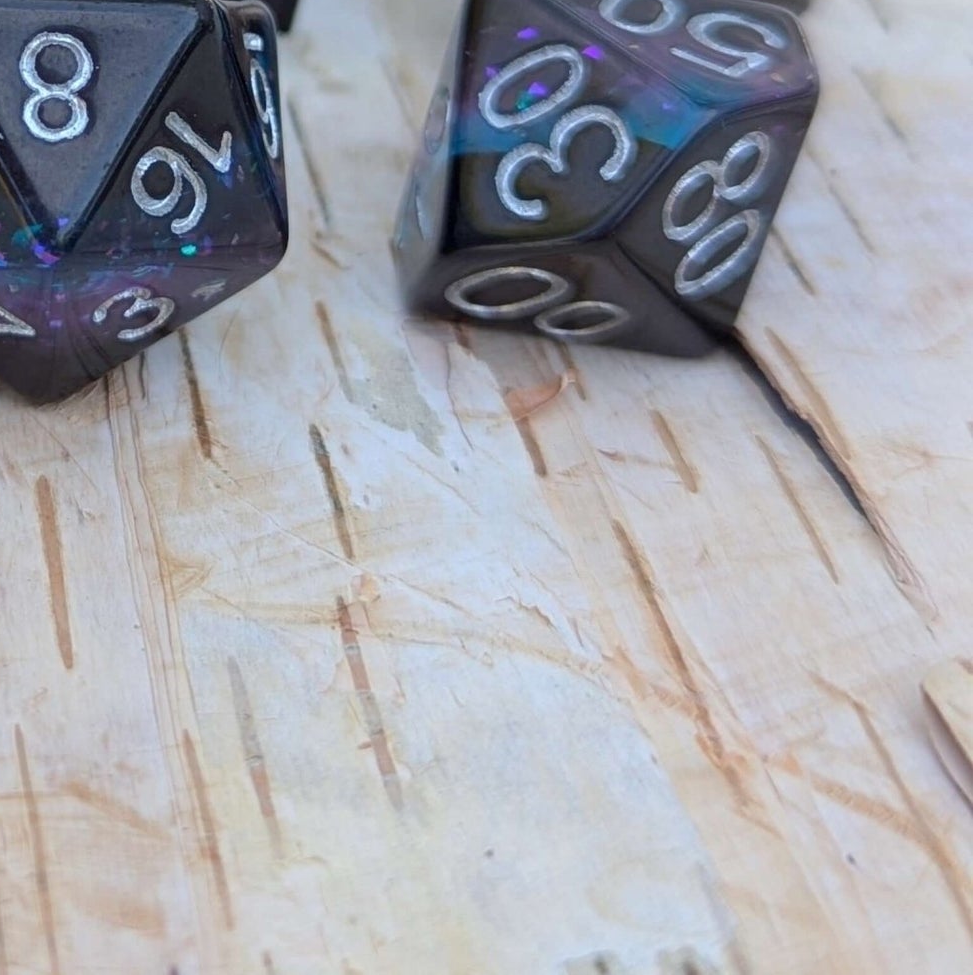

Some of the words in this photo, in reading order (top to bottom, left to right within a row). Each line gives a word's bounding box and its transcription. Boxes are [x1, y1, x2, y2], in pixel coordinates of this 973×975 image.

[19, 31, 95, 143] 8
[478, 44, 634, 222] 30
[131, 111, 234, 235] 16
[662, 131, 772, 298] 80
[93, 286, 176, 340] 3
[444, 266, 630, 337] 00
